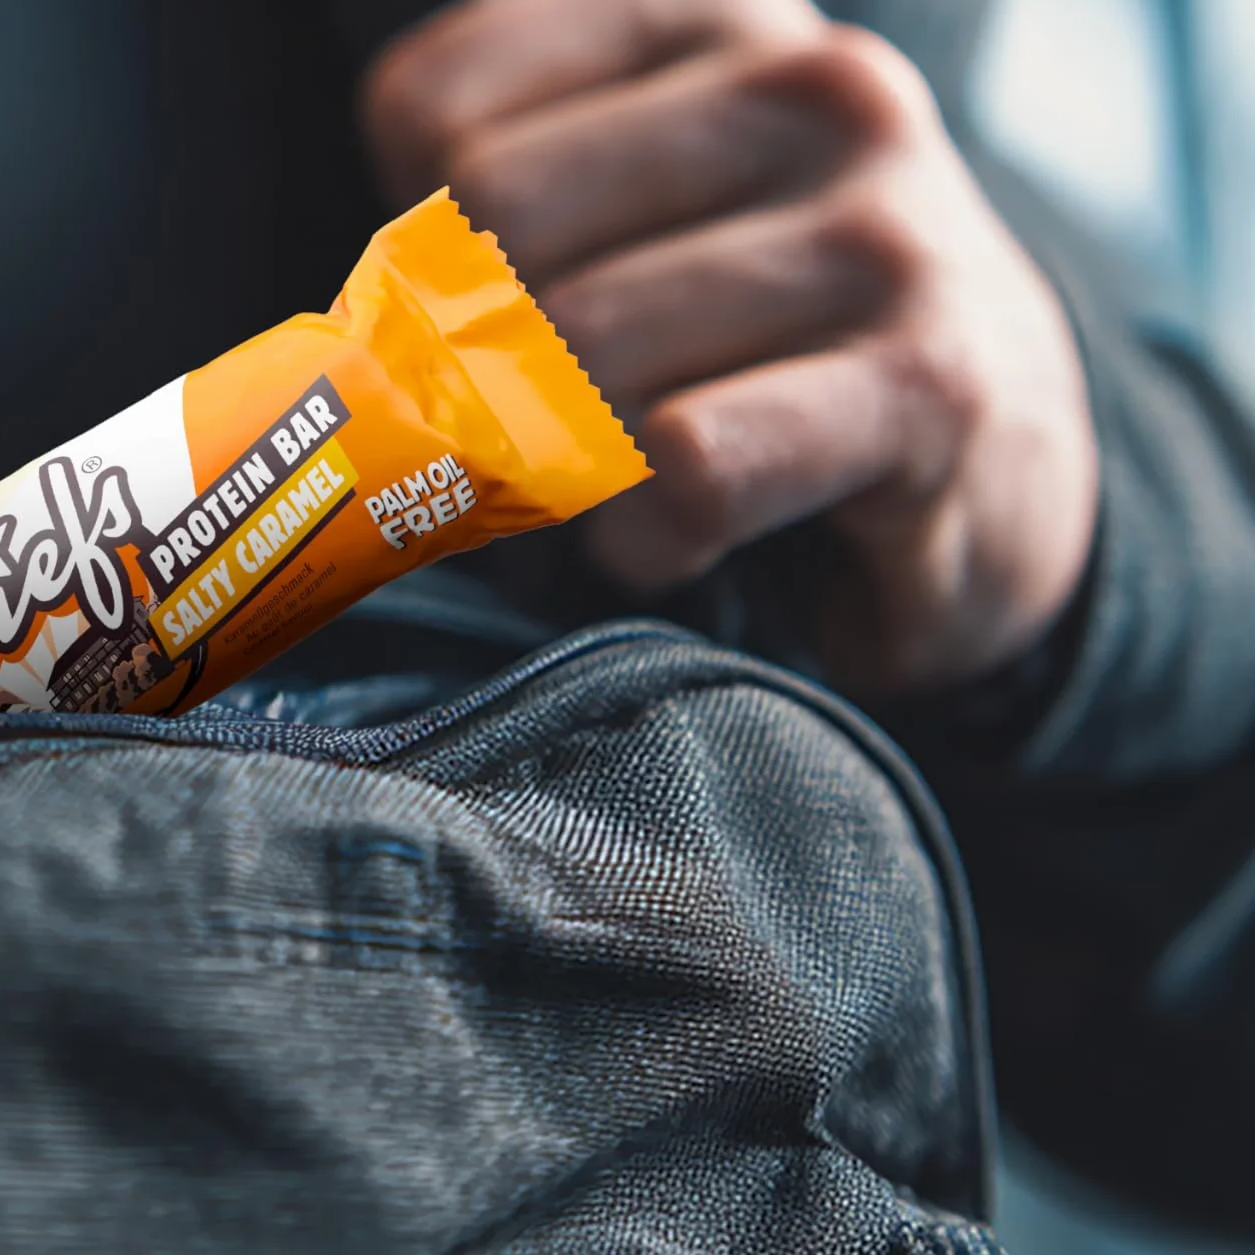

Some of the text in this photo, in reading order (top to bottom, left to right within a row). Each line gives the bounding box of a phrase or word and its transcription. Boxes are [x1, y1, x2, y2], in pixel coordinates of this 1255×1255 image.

[149, 394, 338, 585] PROTEIN BAR
[162, 557, 237, 646] SALTY
[234, 457, 345, 574] CARAMEL
[364, 452, 466, 525] PALM OIL
[379, 476, 478, 550] FREE
